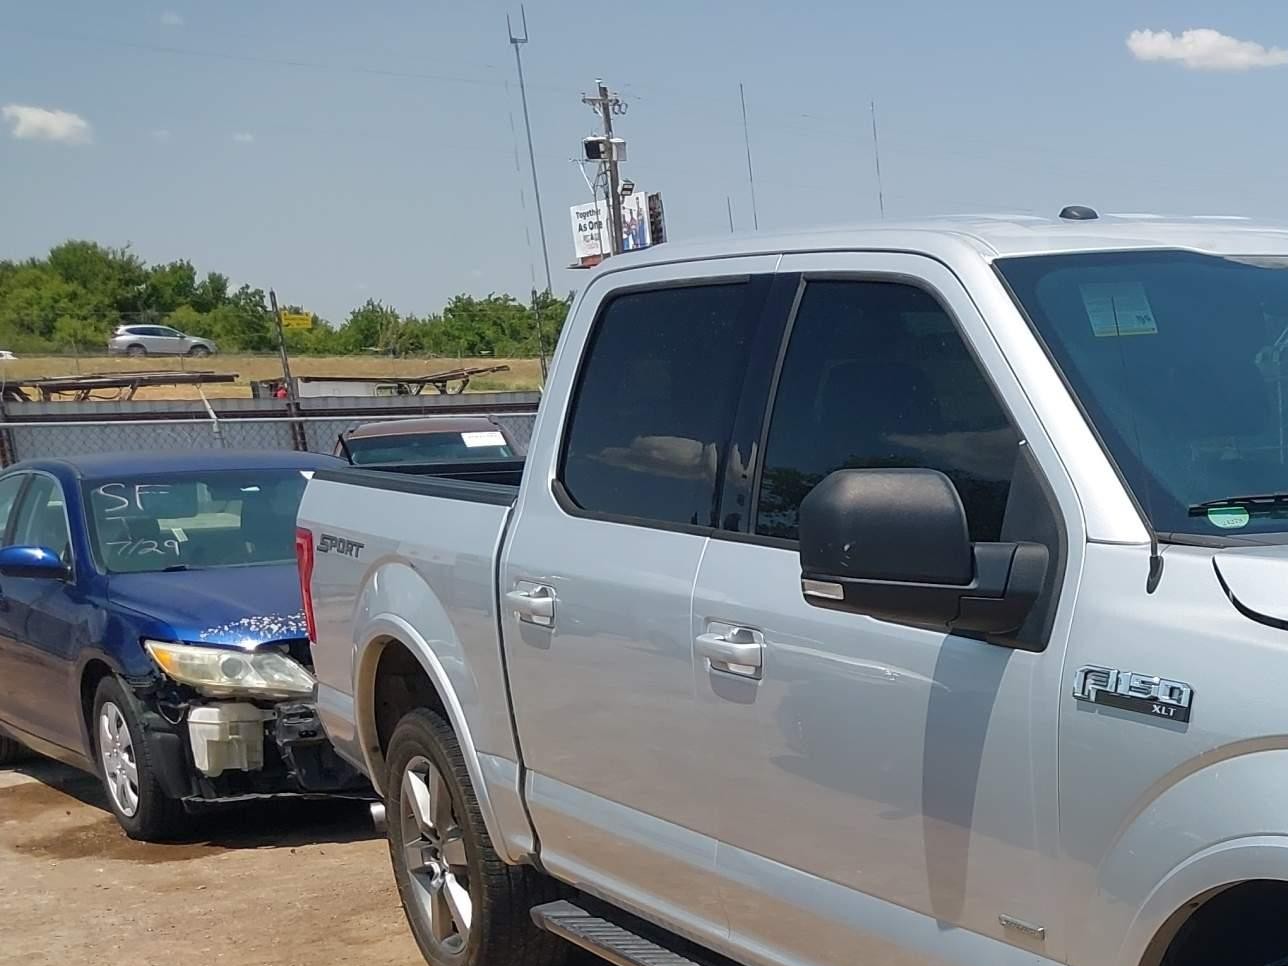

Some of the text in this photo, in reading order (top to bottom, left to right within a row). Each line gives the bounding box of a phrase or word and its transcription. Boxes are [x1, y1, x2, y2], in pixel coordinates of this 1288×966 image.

[578, 221, 588, 232] As
[105, 539, 180, 556] 7/29
[316, 533, 365, 558] SPORT
[1151, 704, 1177, 717] XLT
